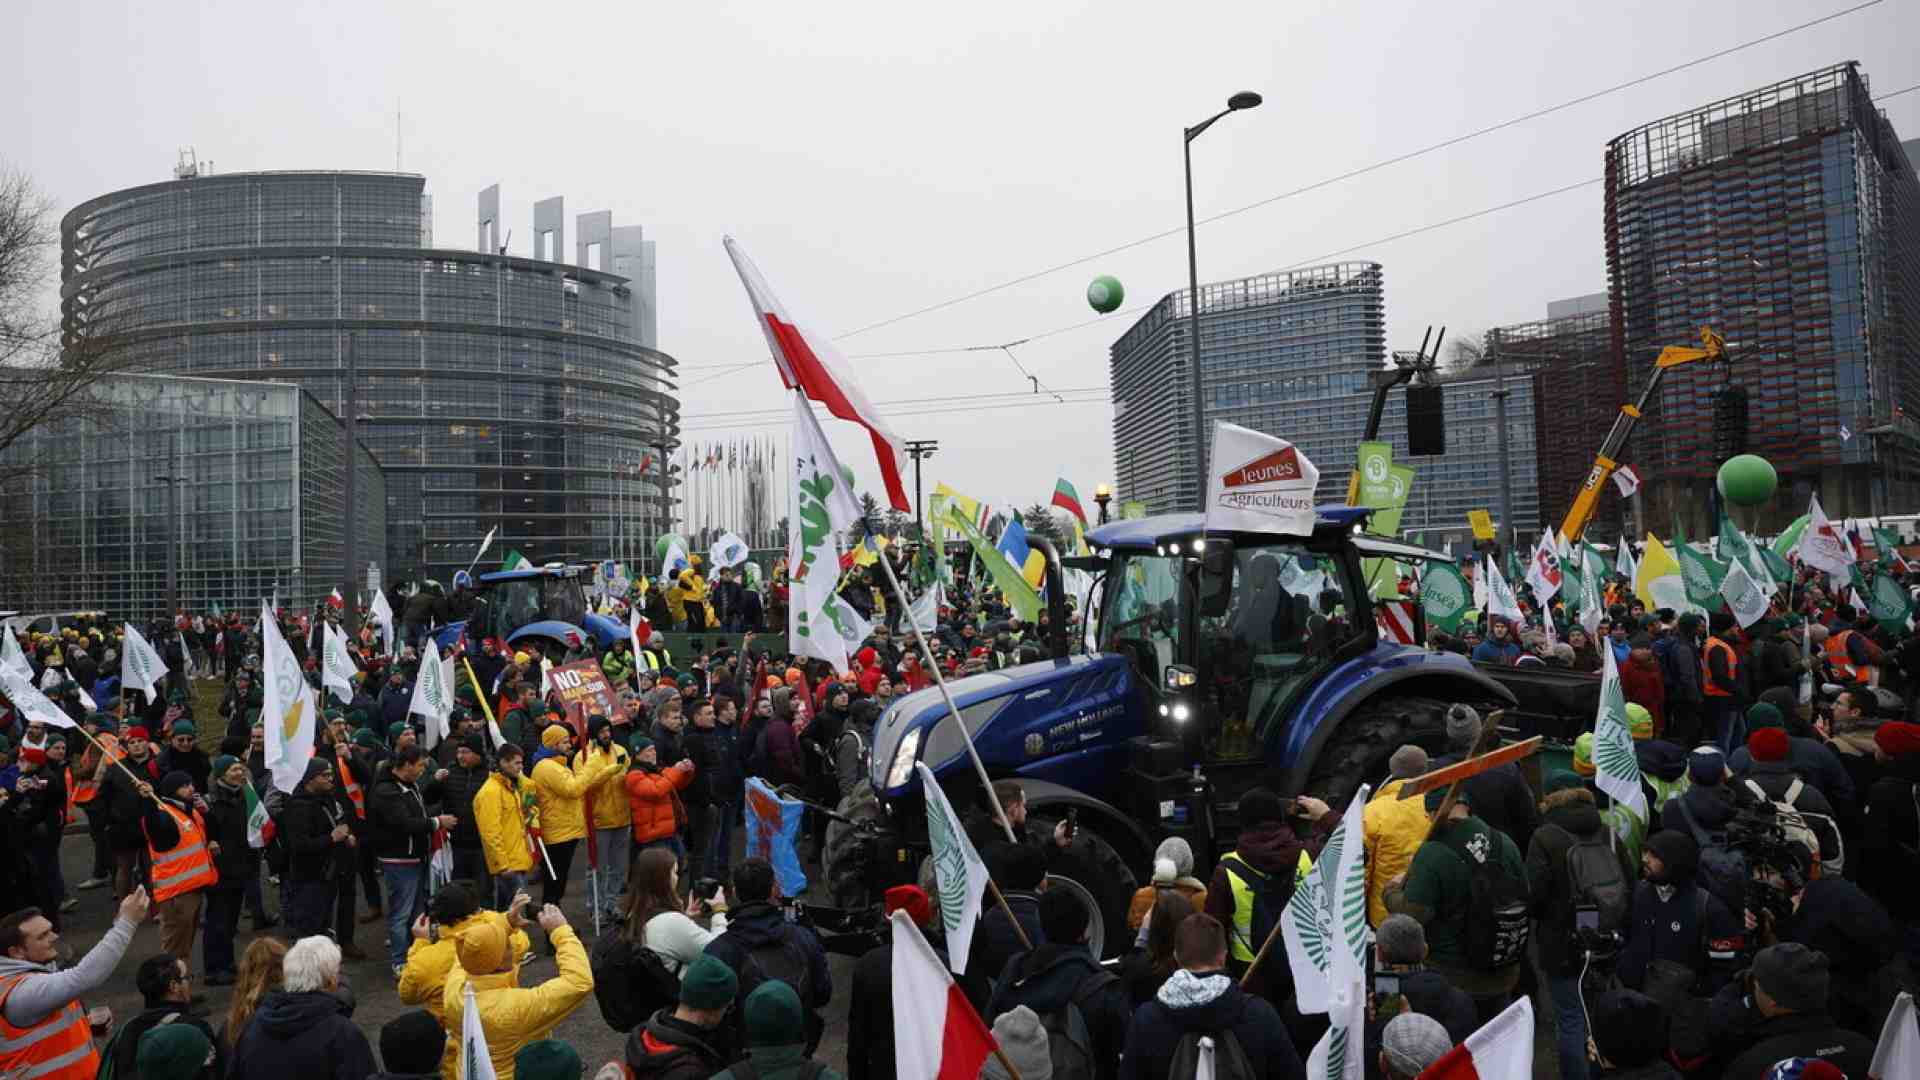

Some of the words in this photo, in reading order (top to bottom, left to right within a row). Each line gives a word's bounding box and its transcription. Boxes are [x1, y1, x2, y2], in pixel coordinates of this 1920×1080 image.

[1240, 462, 1294, 484] Jeunes
[1227, 493, 1312, 510] Agriculteurs
[553, 669, 582, 690] NO
